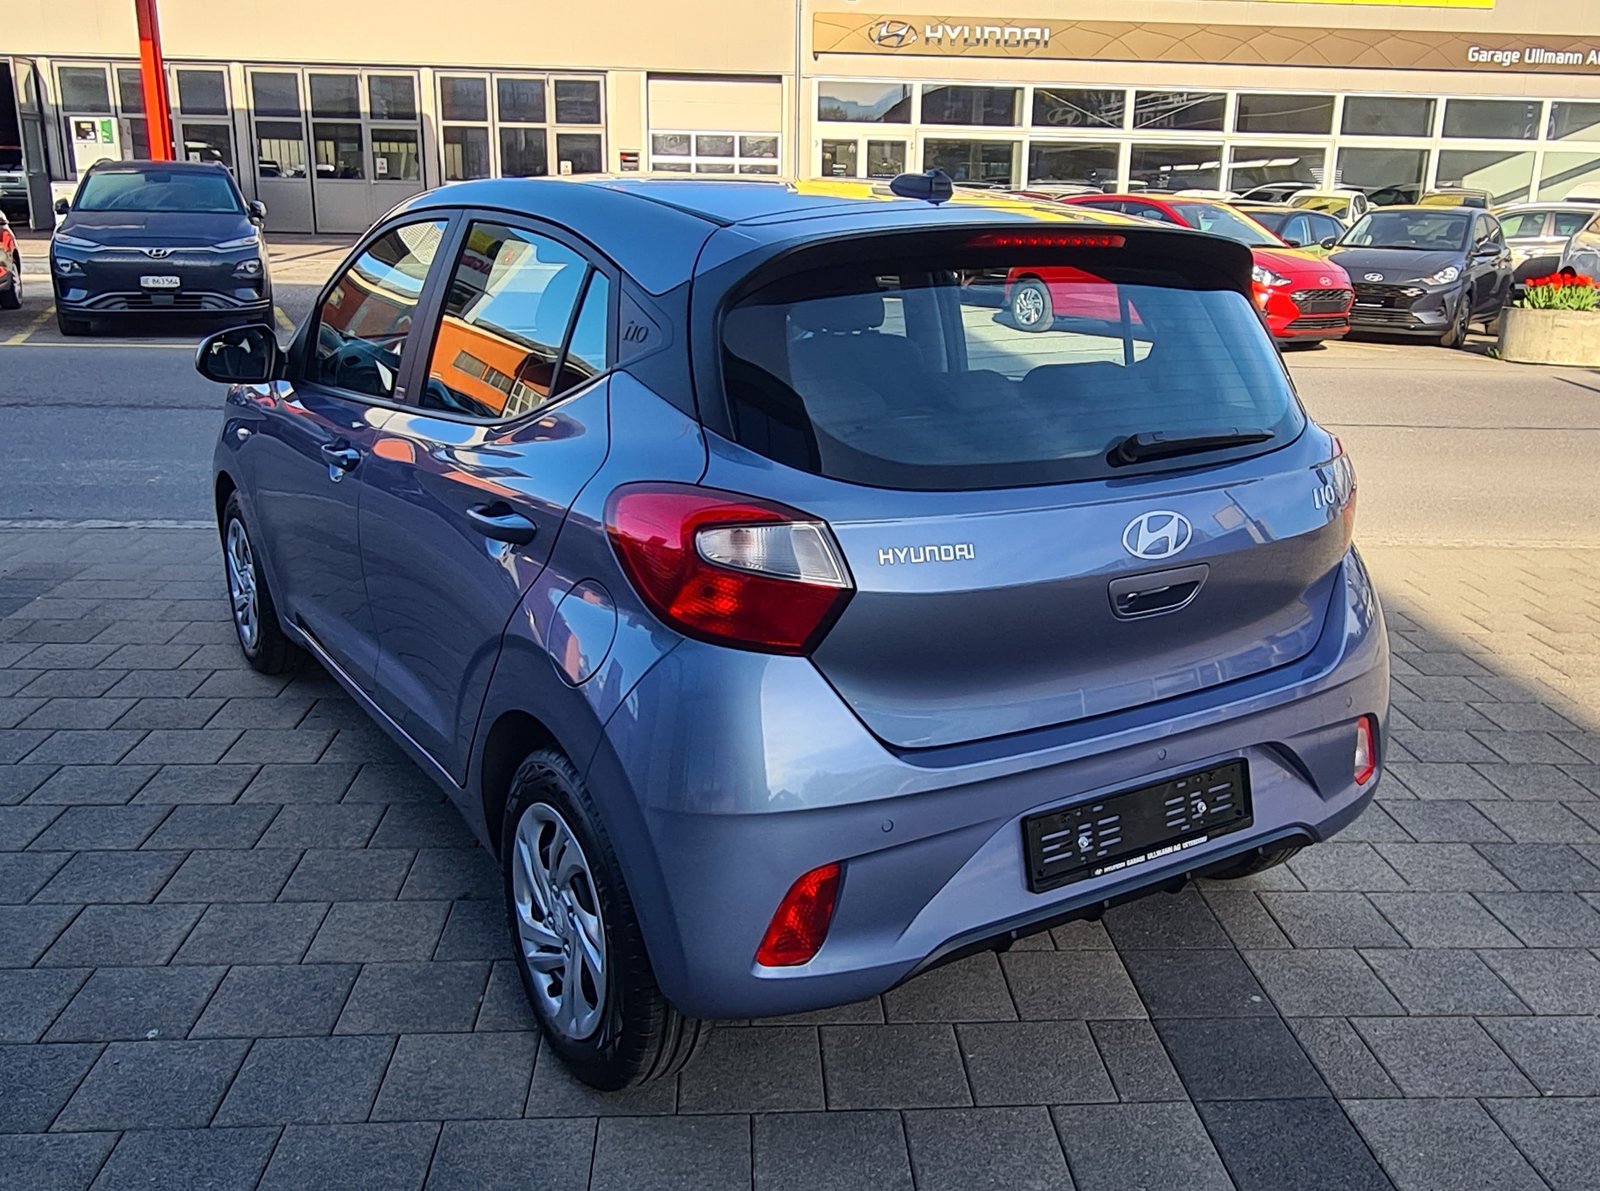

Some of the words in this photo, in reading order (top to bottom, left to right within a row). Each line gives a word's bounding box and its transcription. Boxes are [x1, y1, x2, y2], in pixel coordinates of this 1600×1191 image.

[924, 23, 1051, 49] HYUNDAI
[1467, 46, 1521, 67] Garage
[1523, 47, 1584, 65] Ullmann
[622, 319, 650, 344] i10
[878, 543, 975, 566] HYUNDAI
